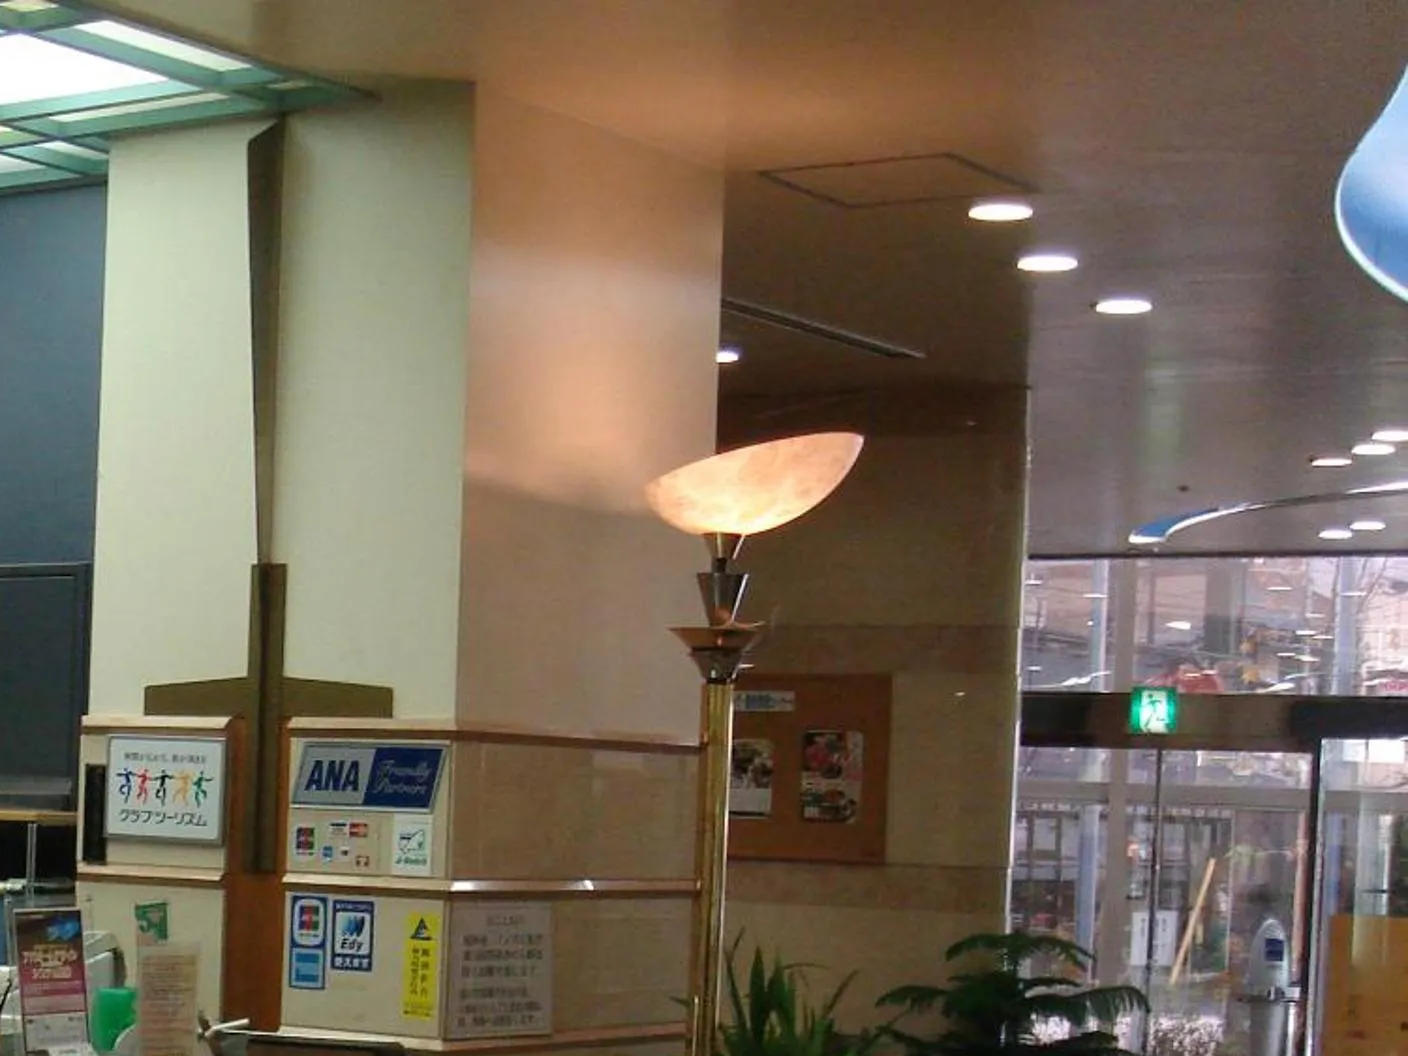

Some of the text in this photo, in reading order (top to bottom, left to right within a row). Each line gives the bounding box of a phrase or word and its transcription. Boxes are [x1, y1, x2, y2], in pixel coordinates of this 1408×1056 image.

[304, 759, 360, 792] ANA
[119, 808, 208, 827] クラブツーリズム
[340, 938, 363, 951] Edy
